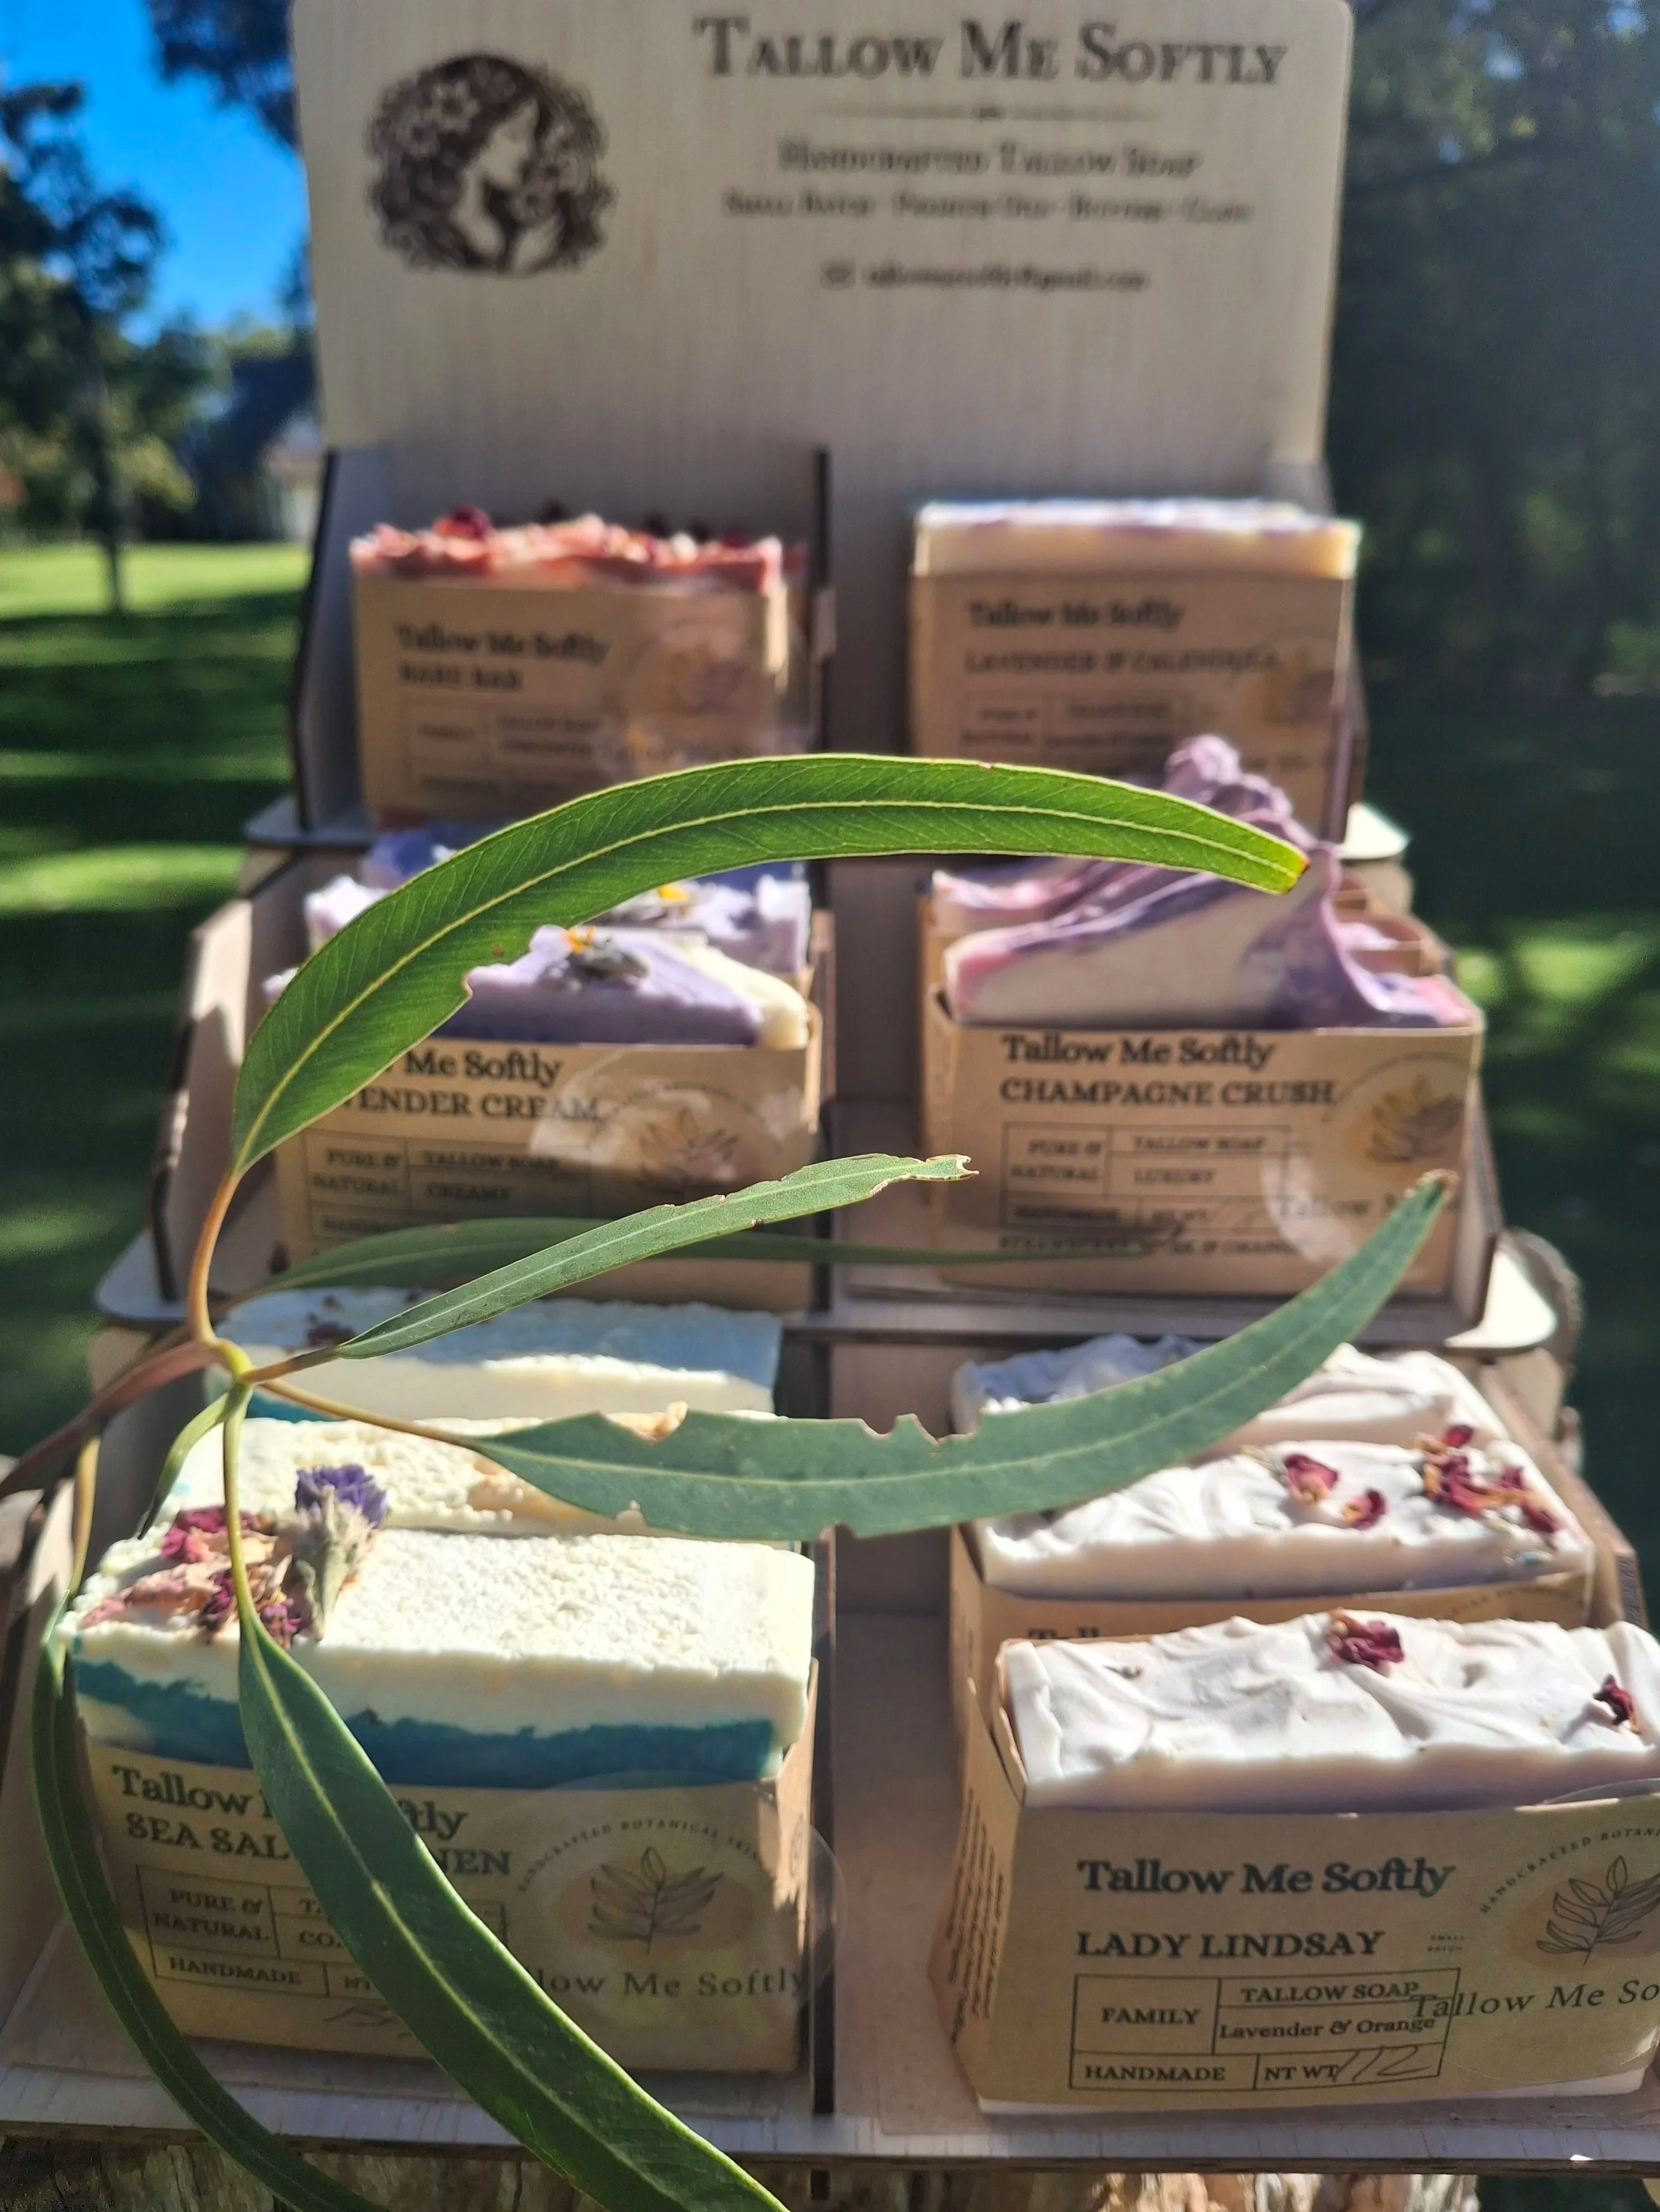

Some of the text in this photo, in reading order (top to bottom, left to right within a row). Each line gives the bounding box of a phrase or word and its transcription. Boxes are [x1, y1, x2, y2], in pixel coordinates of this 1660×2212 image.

[1001, 1033, 1276, 1072] Tallow Me Softly
[406, 1050, 562, 1087] Me Softly
[347, 1086, 471, 1116] ENDER
[1001, 1078, 1335, 1106] CHAMPAGNE CRUSH
[112, 1765, 252, 1816] Tallow
[126, 1812, 203, 1850] SEA
[211, 1827, 290, 1859] SAL
[1078, 1857, 1455, 1897] Tallow Me Softly
[1479, 1827, 1660, 1914] HANDCRAFTED BOTANI
[170, 1887, 234, 1911] PURE
[155, 1913, 271, 1941] NATURAL
[1077, 1931, 1384, 1959] LADY LINDSAY
[169, 1956, 301, 1985] HANDMADE
[623, 1971, 682, 1996] Me
[1242, 1982, 1419, 2004] TALLOW SOAP
[1409, 1993, 1534, 2019] Tallow
[1546, 1984, 1604, 2010] Me
[1102, 2008, 1201, 2025] FAMILY
[1219, 2016, 1435, 2039] Lavender & Orange
[1085, 2065, 1224, 2081] HANDMADE
[1264, 2064, 1339, 2081] NT WT
